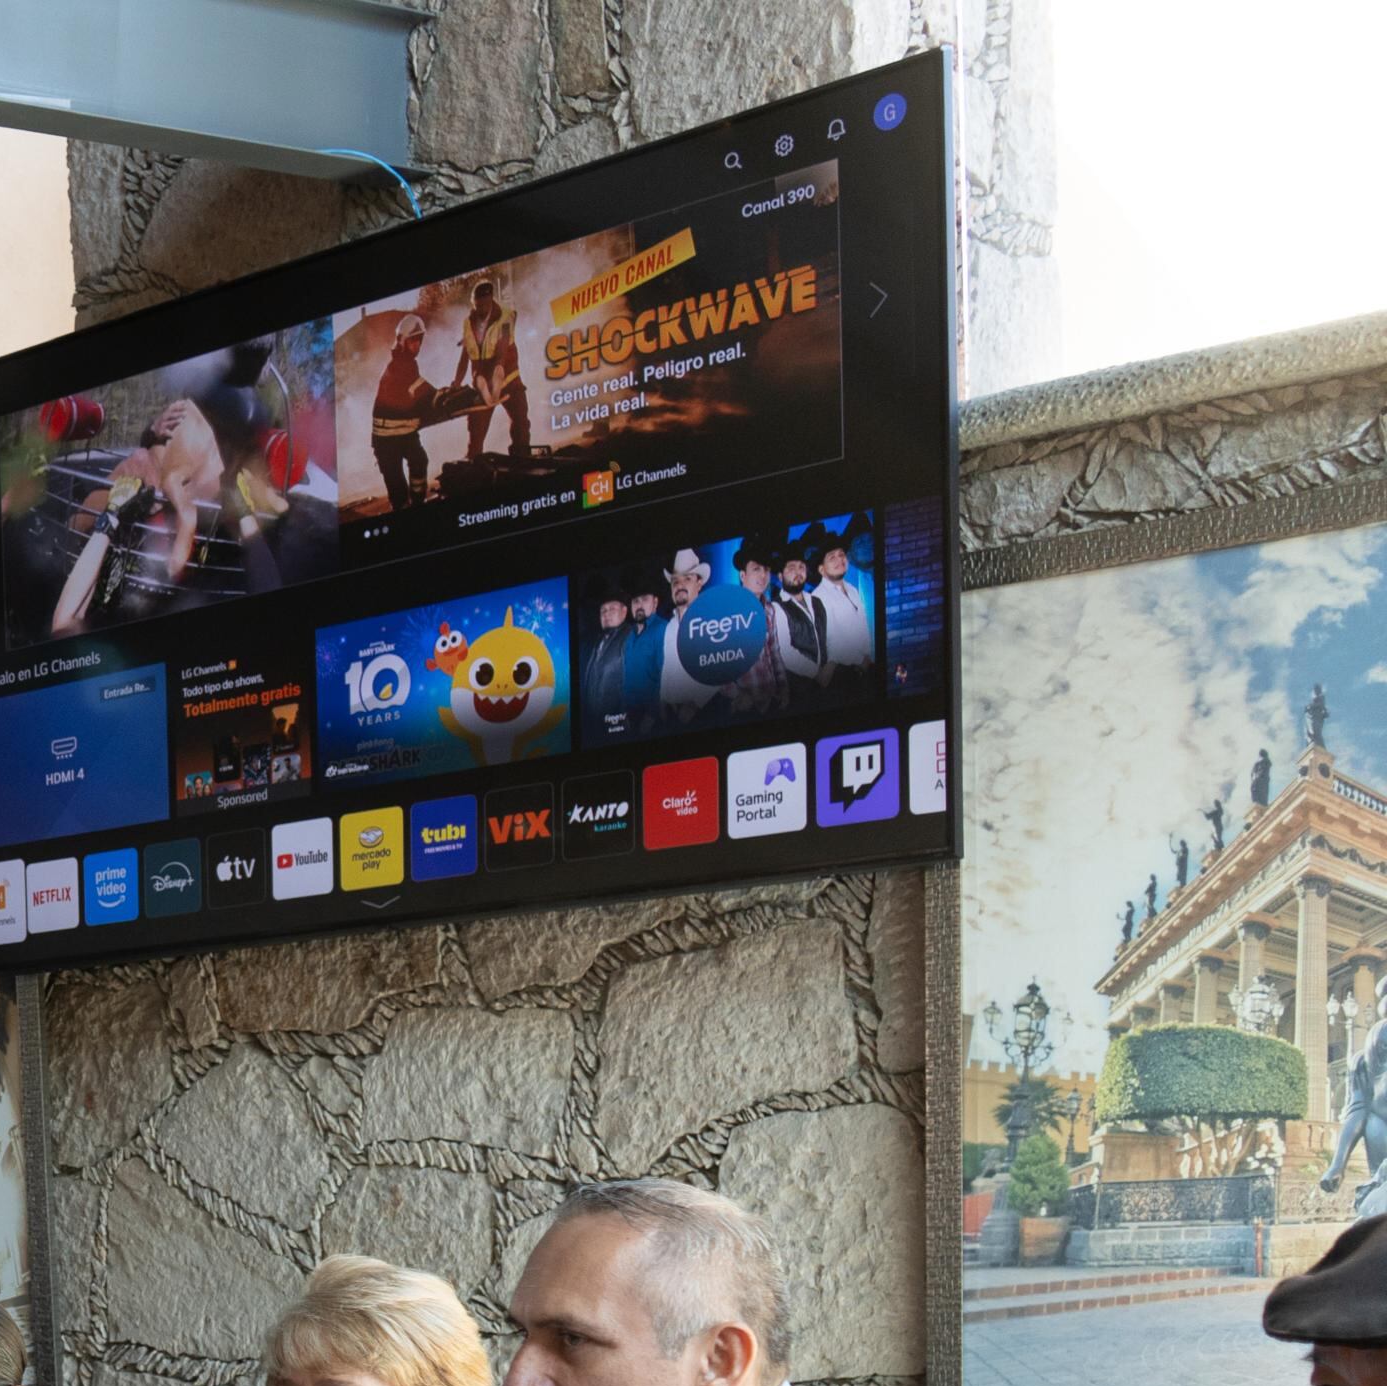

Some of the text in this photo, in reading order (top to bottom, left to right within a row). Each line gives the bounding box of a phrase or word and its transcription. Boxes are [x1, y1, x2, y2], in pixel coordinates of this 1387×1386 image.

[741, 184, 815, 219] Canal 390
[570, 244, 674, 315] NUEVO CANAL
[545, 265, 817, 380] SHOCKWAVE
[550, 342, 746, 408] Gente real. Peligro real.
[550, 392, 649, 432] La vida real.
[458, 462, 687, 528] Streaming gratis en CH LG Channels
[18, 667, 32, 682] en
[33, 661, 49, 679] LG
[51, 651, 101, 674] Channels
[698, 648, 745, 668] BANDA
[181, 661, 227, 680] LG Channels
[103, 683, 133, 699] Entrada
[182, 686, 203, 698] Todo
[204, 681, 222, 694] tipo
[222, 680, 234, 689] de
[344, 653, 411, 716] 10
[183, 682, 301, 718] Totalmente gratis
[357, 710, 402, 728] YEARS
[45, 767, 85, 786] HDMI 4
[217, 788, 268, 810] Sponsored
[662, 795, 692, 811] Claro
[735, 789, 784, 807] Gaming
[568, 801, 629, 825] KANTO
[676, 804, 698, 817] video
[736, 805, 777, 823] Portal
[421, 823, 466, 845] tubi
[488, 808, 552, 845] ViX
[594, 821, 628, 833] karaoke
[294, 849, 329, 867] YouTube
[352, 847, 392, 862] mercado
[362, 858, 382, 872] play
[95, 866, 127, 885] prime
[32, 886, 72, 908] NETFLIX
[96, 881, 127, 897] video
